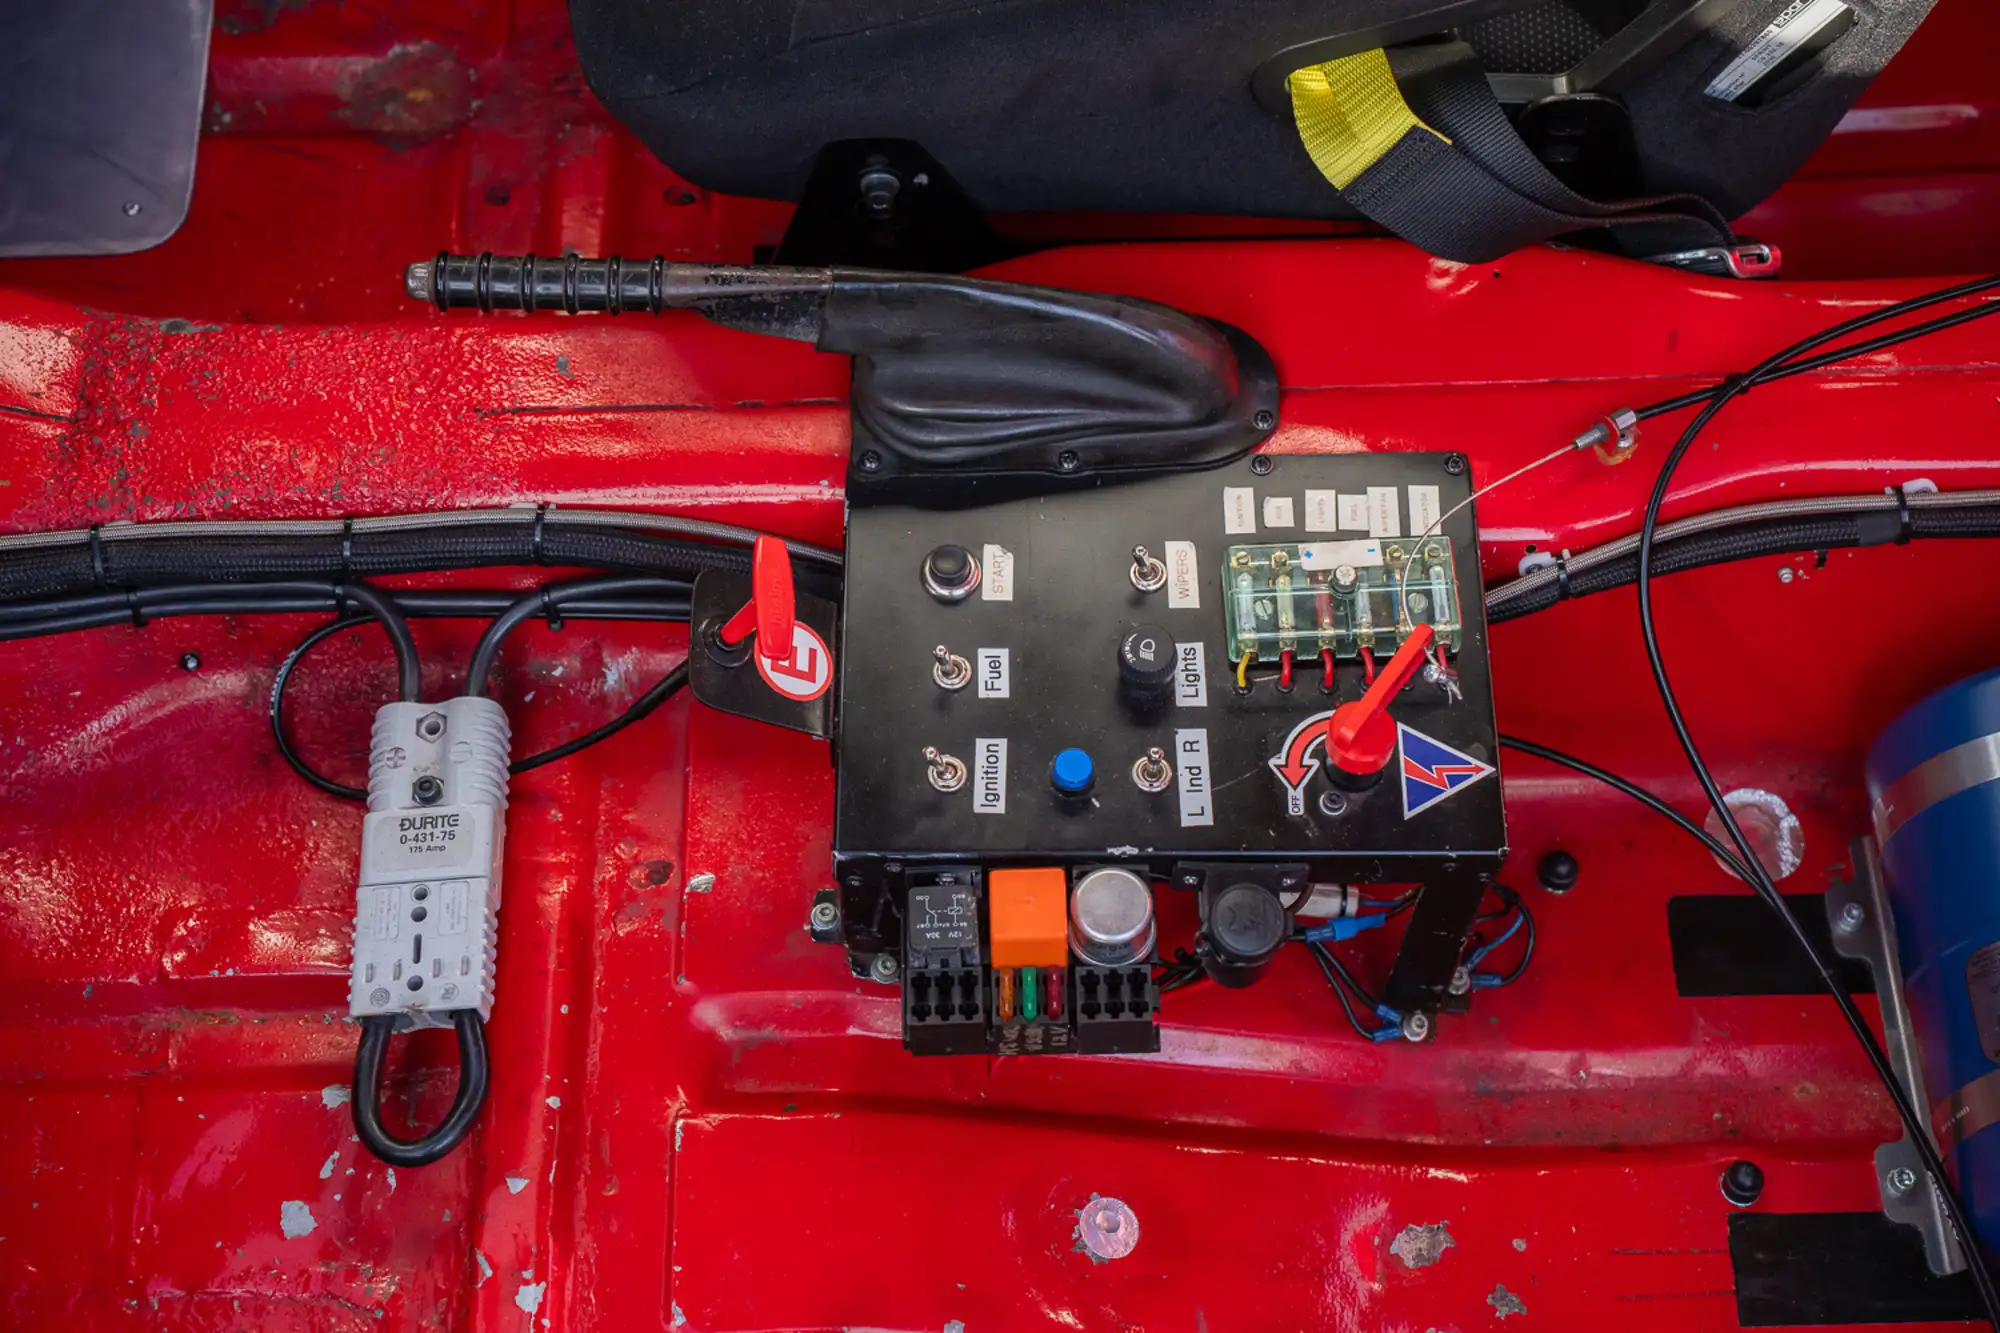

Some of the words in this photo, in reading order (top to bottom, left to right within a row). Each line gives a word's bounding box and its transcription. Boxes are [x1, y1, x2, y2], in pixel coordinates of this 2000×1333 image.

[992, 552, 1005, 595] START
[984, 654, 1002, 692] Fuel
[1180, 646, 1201, 699] Lights
[1182, 740, 1201, 753] R
[979, 743, 1002, 808] Ignition
[1184, 765, 1204, 793] Ind
[1187, 805, 1205, 817] L
[1291, 794, 1301, 814] OFF
[399, 829, 456, 845] 0-431-75
[409, 846, 423, 854] 175
[425, 844, 447, 852] Amp
[948, 931, 962, 939] 12V
